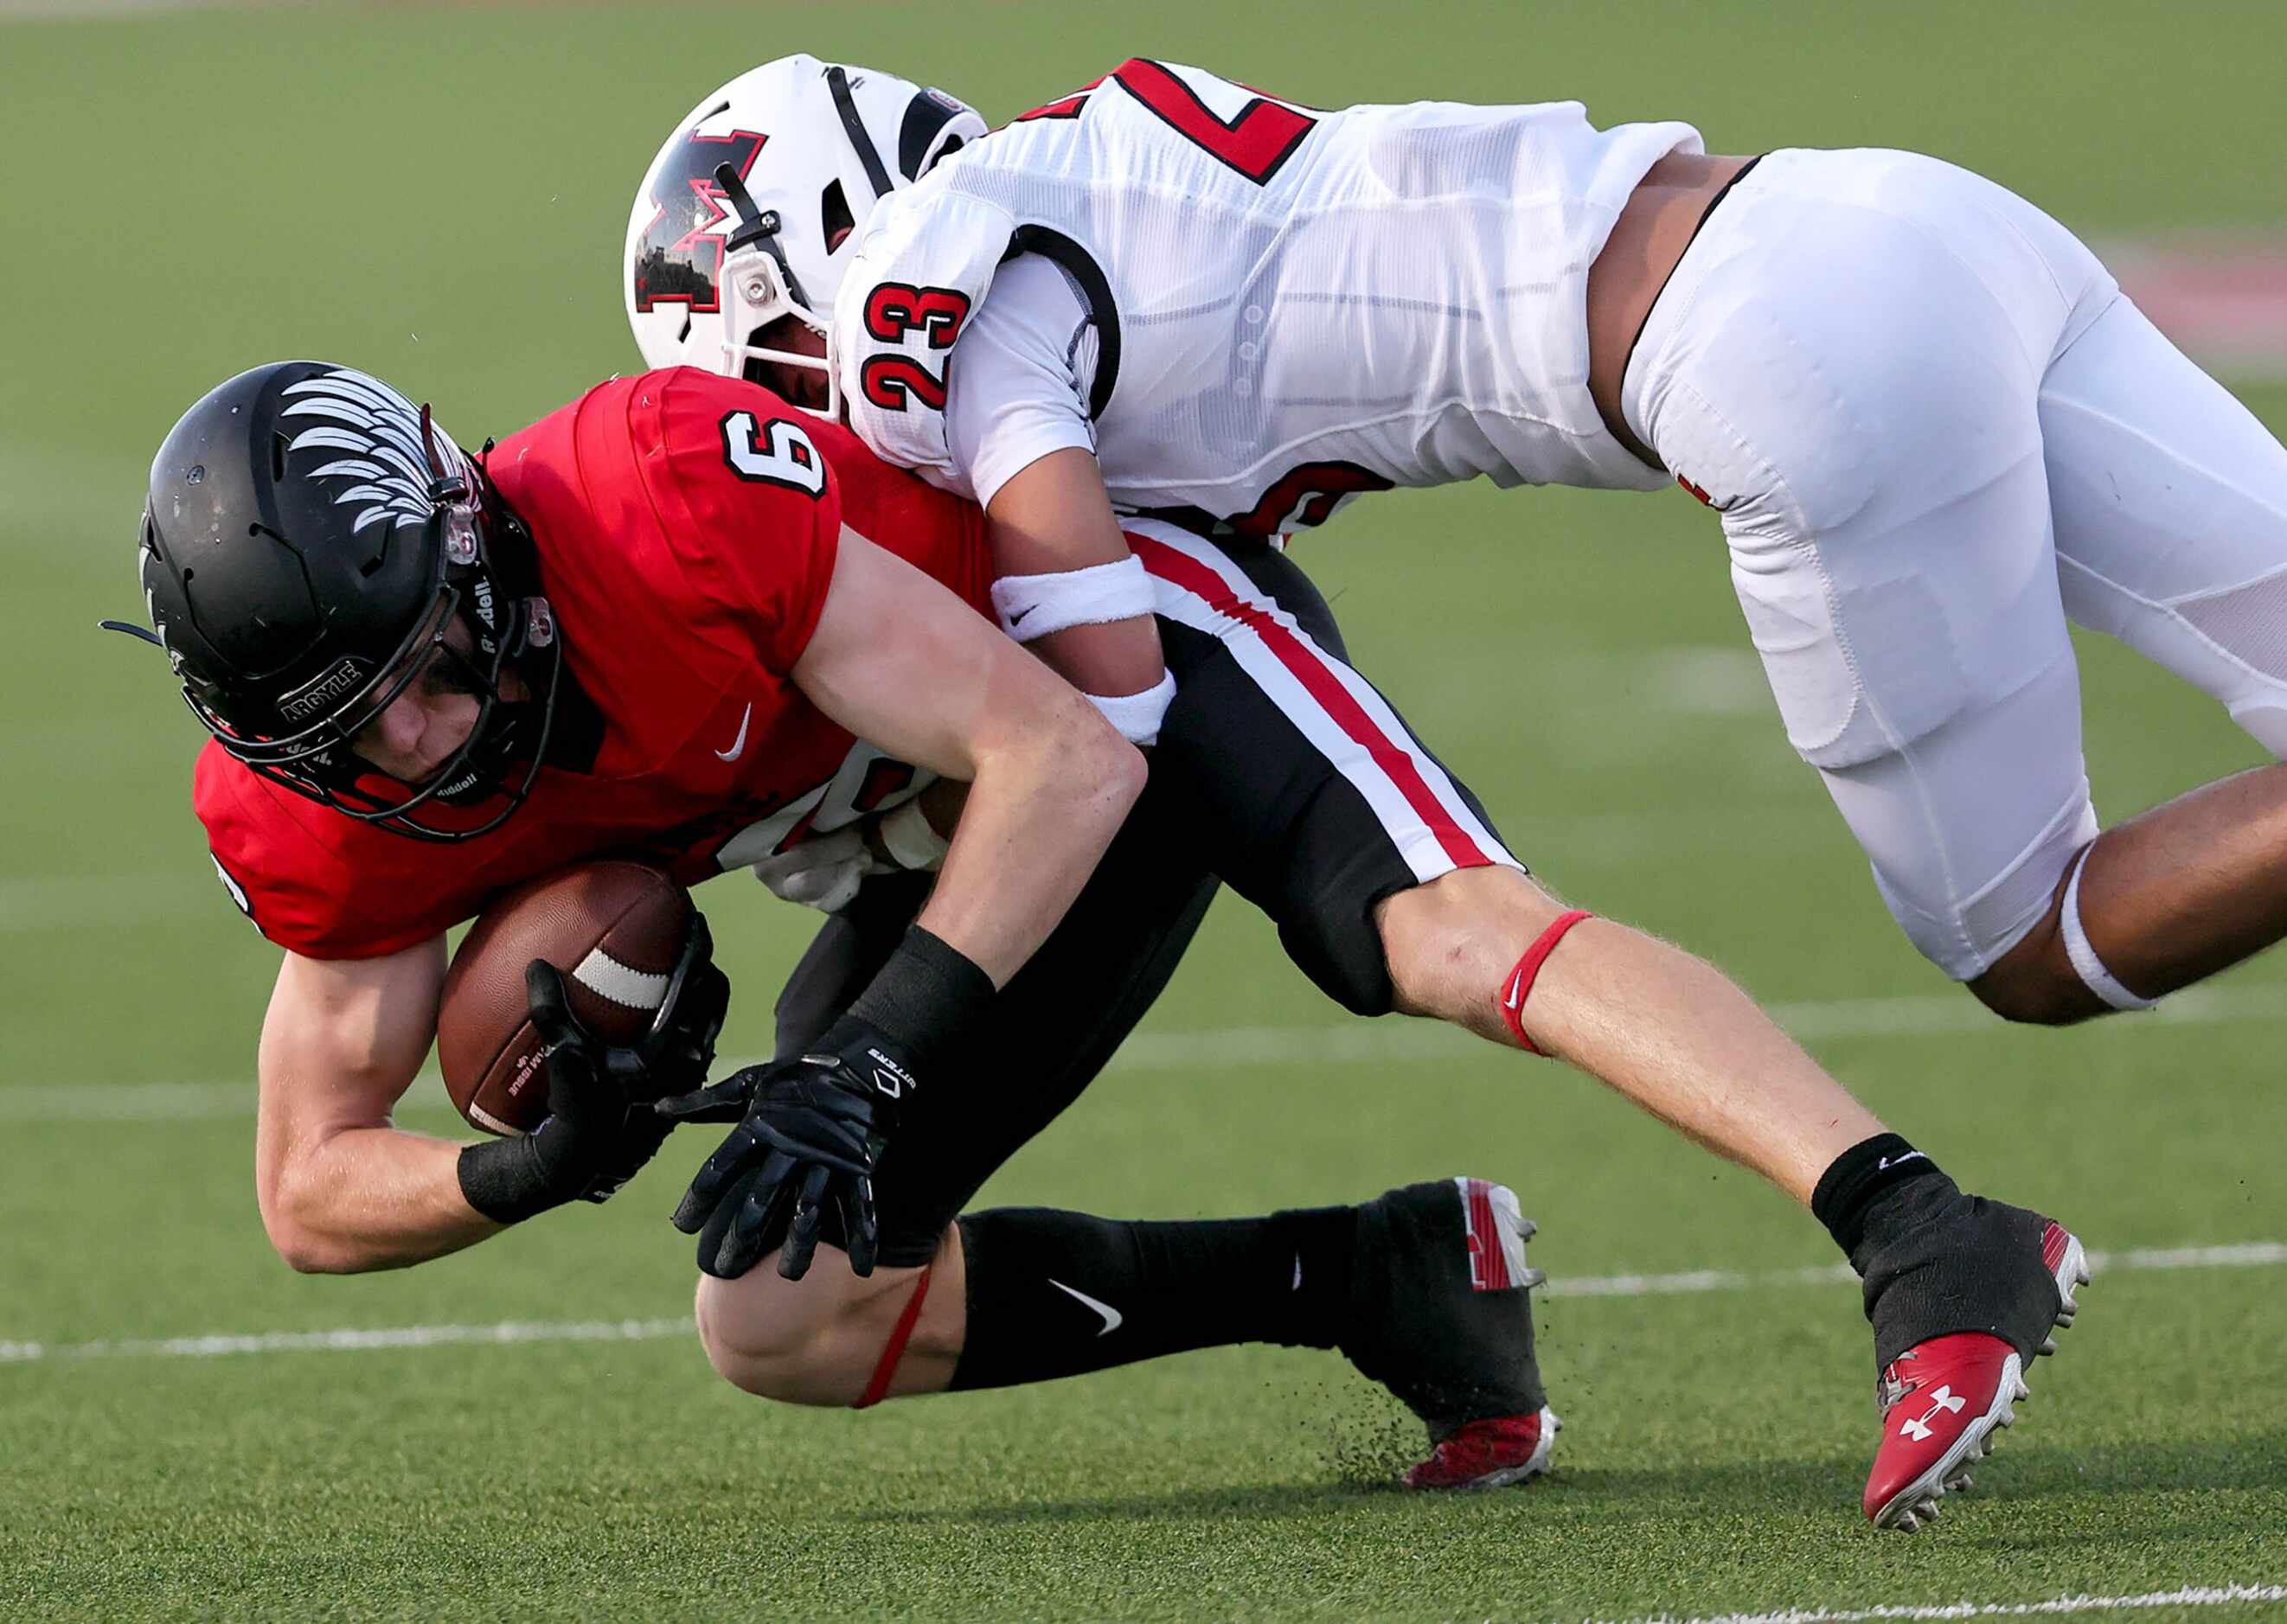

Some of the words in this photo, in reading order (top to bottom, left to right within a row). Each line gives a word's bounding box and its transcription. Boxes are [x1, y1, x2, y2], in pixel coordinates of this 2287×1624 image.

[861, 281, 971, 412] 23
[718, 409, 826, 502] 6
[279, 660, 363, 723] ARGYLE
[508, 1066, 533, 1097] ISSUE
